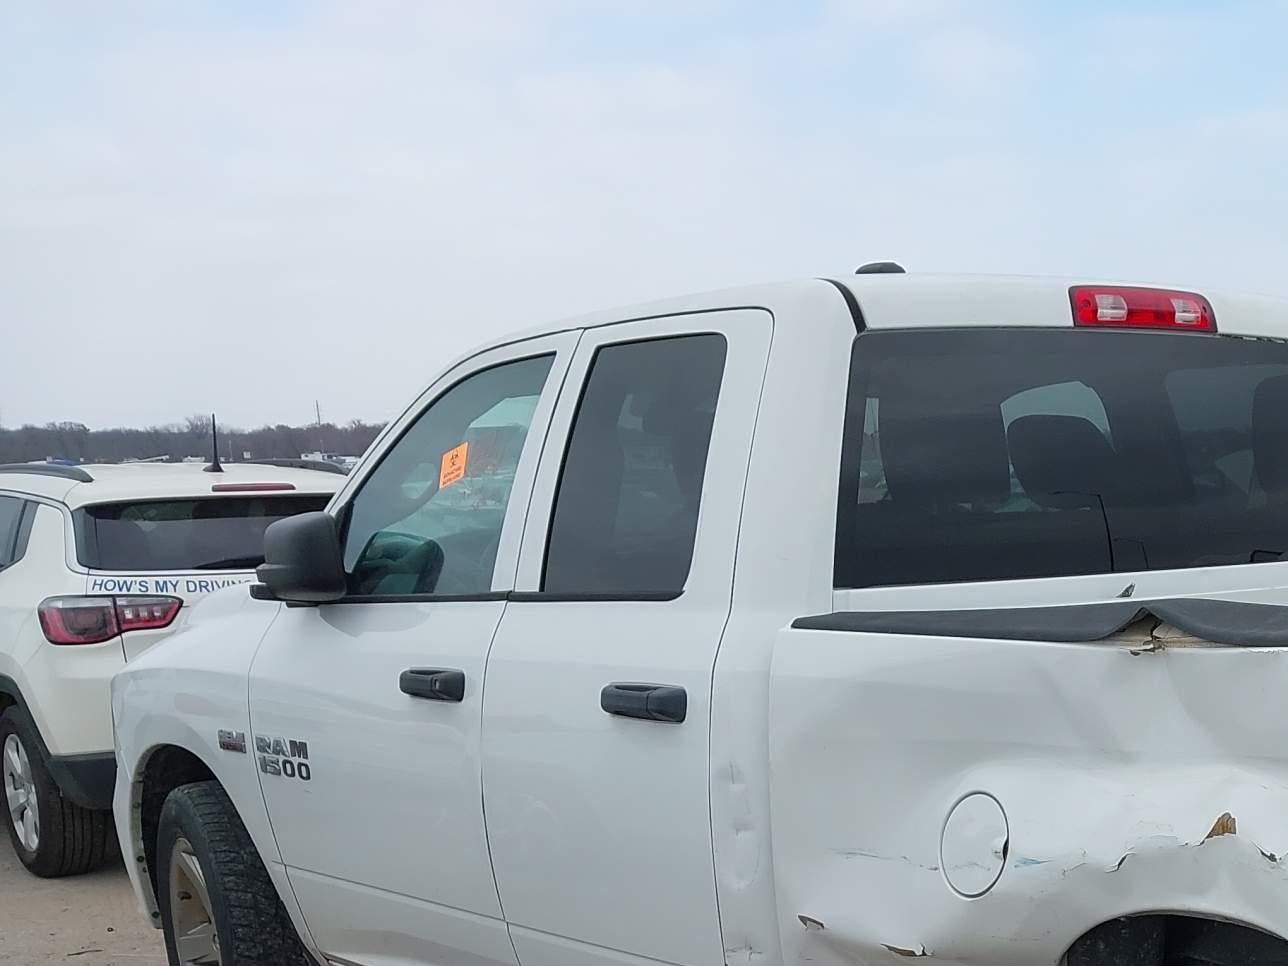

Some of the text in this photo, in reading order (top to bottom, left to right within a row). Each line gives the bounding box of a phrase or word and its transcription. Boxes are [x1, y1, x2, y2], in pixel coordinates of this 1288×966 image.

[91, 578, 149, 593] HOW'S
[155, 579, 180, 593] MY
[255, 736, 309, 759] RAM
[258, 755, 311, 781] 1500
